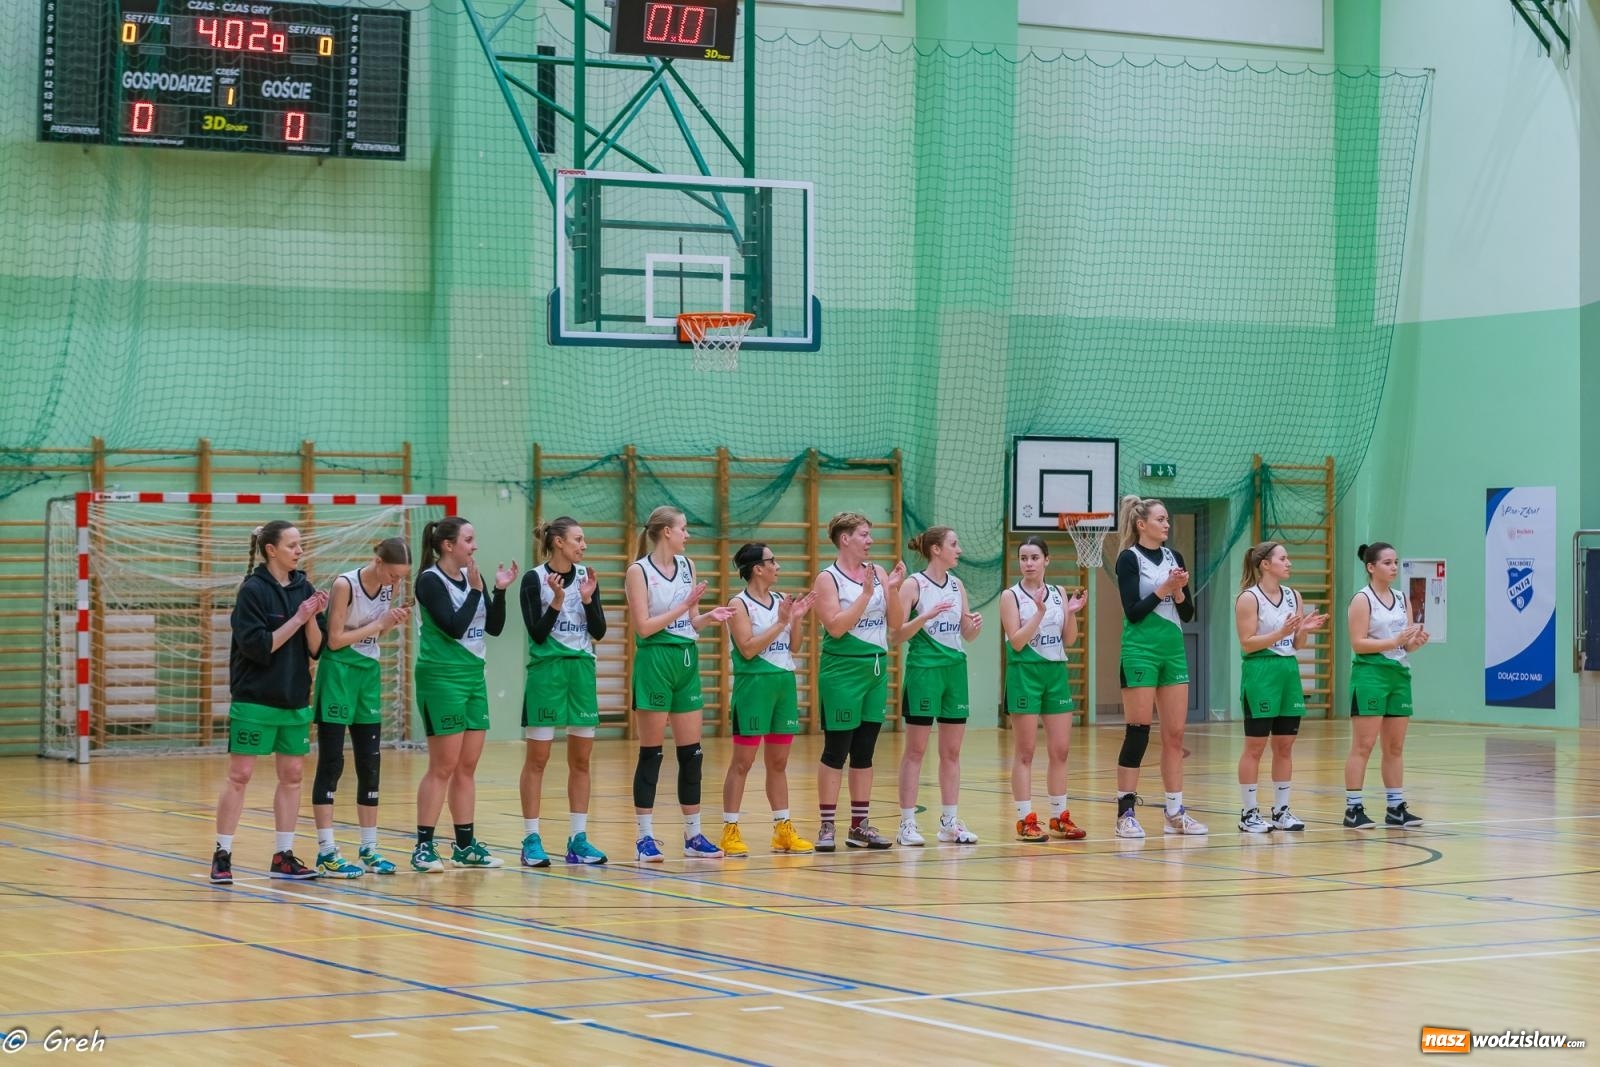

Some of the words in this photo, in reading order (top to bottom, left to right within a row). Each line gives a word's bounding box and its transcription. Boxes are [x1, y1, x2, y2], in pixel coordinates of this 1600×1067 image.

[188, 1, 214, 10] CZAS
[222, 3, 248, 13] CZAS
[252, 5, 272, 14] GRY
[122, 23, 136, 43] 0
[320, 36, 332, 56] 0
[122, 71, 213, 93] GOSPODARZE
[261, 76, 312, 99] GOŚCIE
[133, 102, 153, 133] 0
[285, 112, 304, 141] 0
[1509, 577, 1530, 597] UNIA
[769, 641, 790, 651] Clav
[1041, 635, 1062, 645] Clav
[1134, 670, 1145, 682] 7
[649, 693, 666, 707] 12
[537, 708, 557, 722] 14
[835, 708, 852, 723] 10
[749, 716, 759, 731] 11
[236, 728, 261, 746] 33
